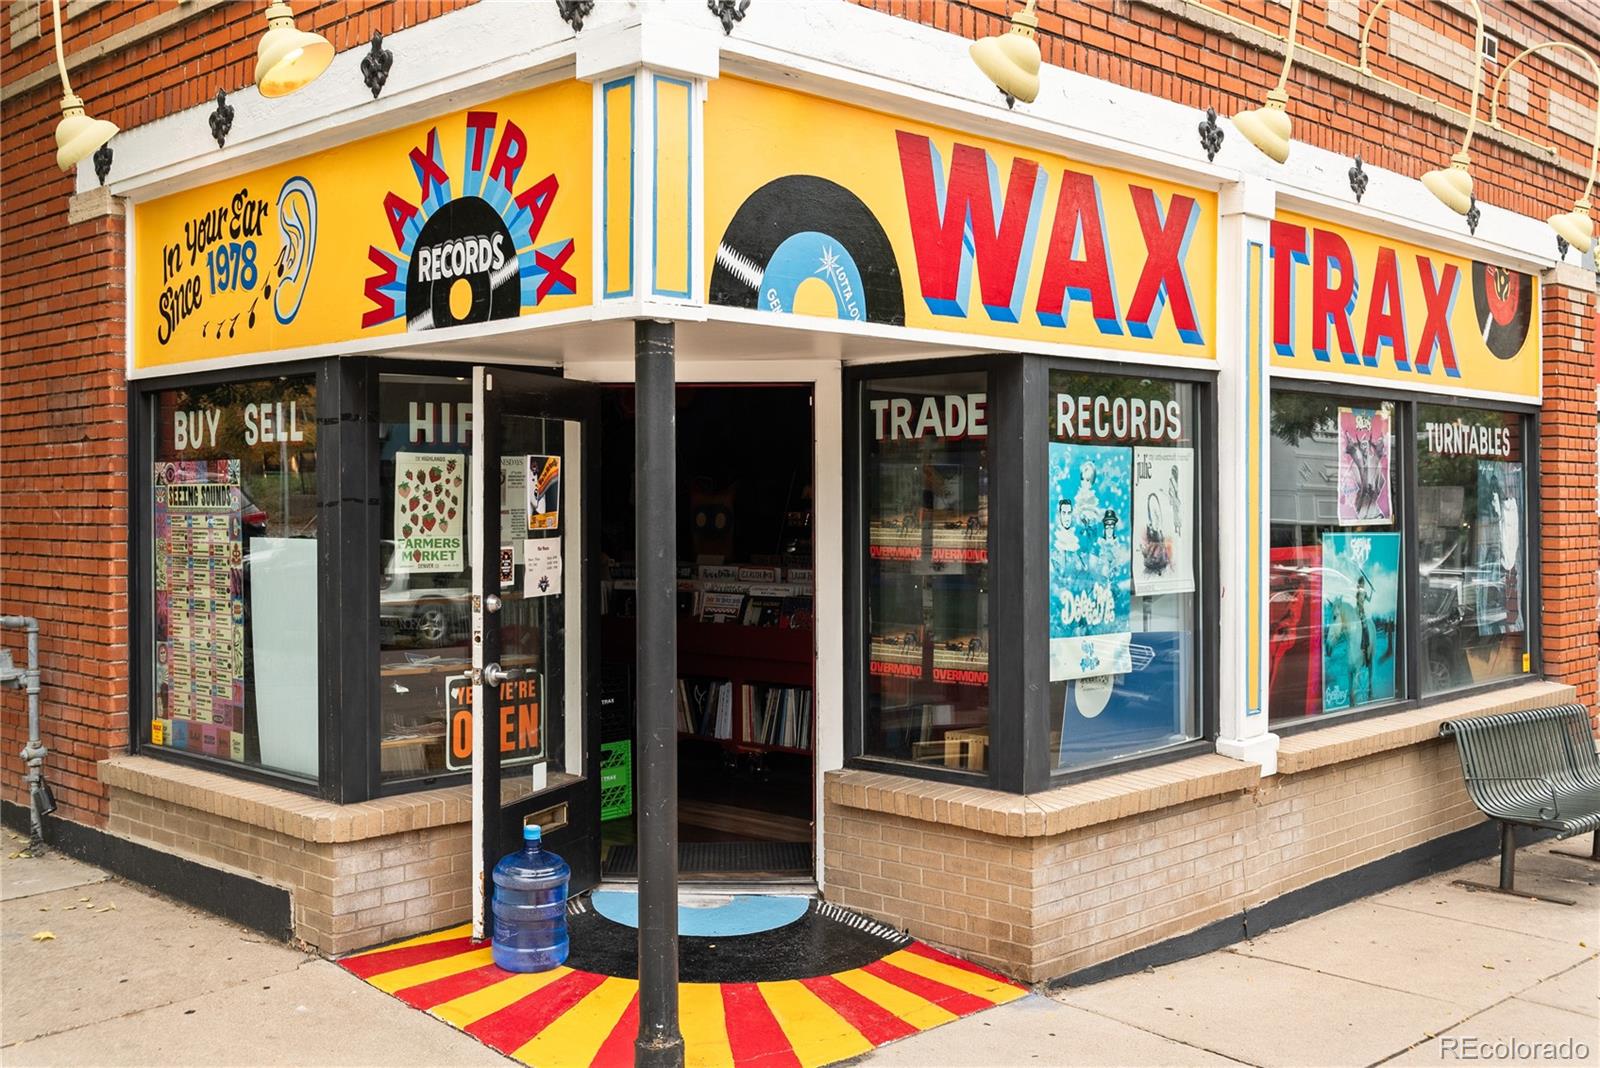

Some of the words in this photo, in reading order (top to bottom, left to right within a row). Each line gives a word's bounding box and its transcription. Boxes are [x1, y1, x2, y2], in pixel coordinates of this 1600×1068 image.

[162, 244, 182, 285] In
[229, 188, 268, 241] Ear
[362, 126, 449, 329] WAX
[464, 111, 577, 307] TRAX
[418, 231, 506, 283] RECORDS
[895, 129, 1205, 346] WAX
[1270, 220, 1462, 379] TRAX
[157, 274, 203, 346] Since
[206, 240, 259, 296] 1978
[836, 266, 854, 303] LOTTA
[174, 408, 222, 451] BUY
[244, 400, 304, 447] SELL
[409, 402, 474, 445] HIF
[869, 393, 989, 441] TRADE
[1056, 393, 1183, 441] RECORDS
[1425, 422, 1511, 458] TURNTABLES
[168, 485, 199, 507] SEEING
[201, 485, 232, 507] SOUNDS
[398, 537, 461, 549] FARMERS
[402, 550, 456, 562] MRKET
[869, 546, 922, 558] OVERMONO
[931, 548, 988, 561] OVERMONO
[869, 661, 922, 676] OVERMONO
[932, 668, 989, 684] OVERMONO
[456, 685, 473, 706] YE
[453, 702, 539, 759] OEN
